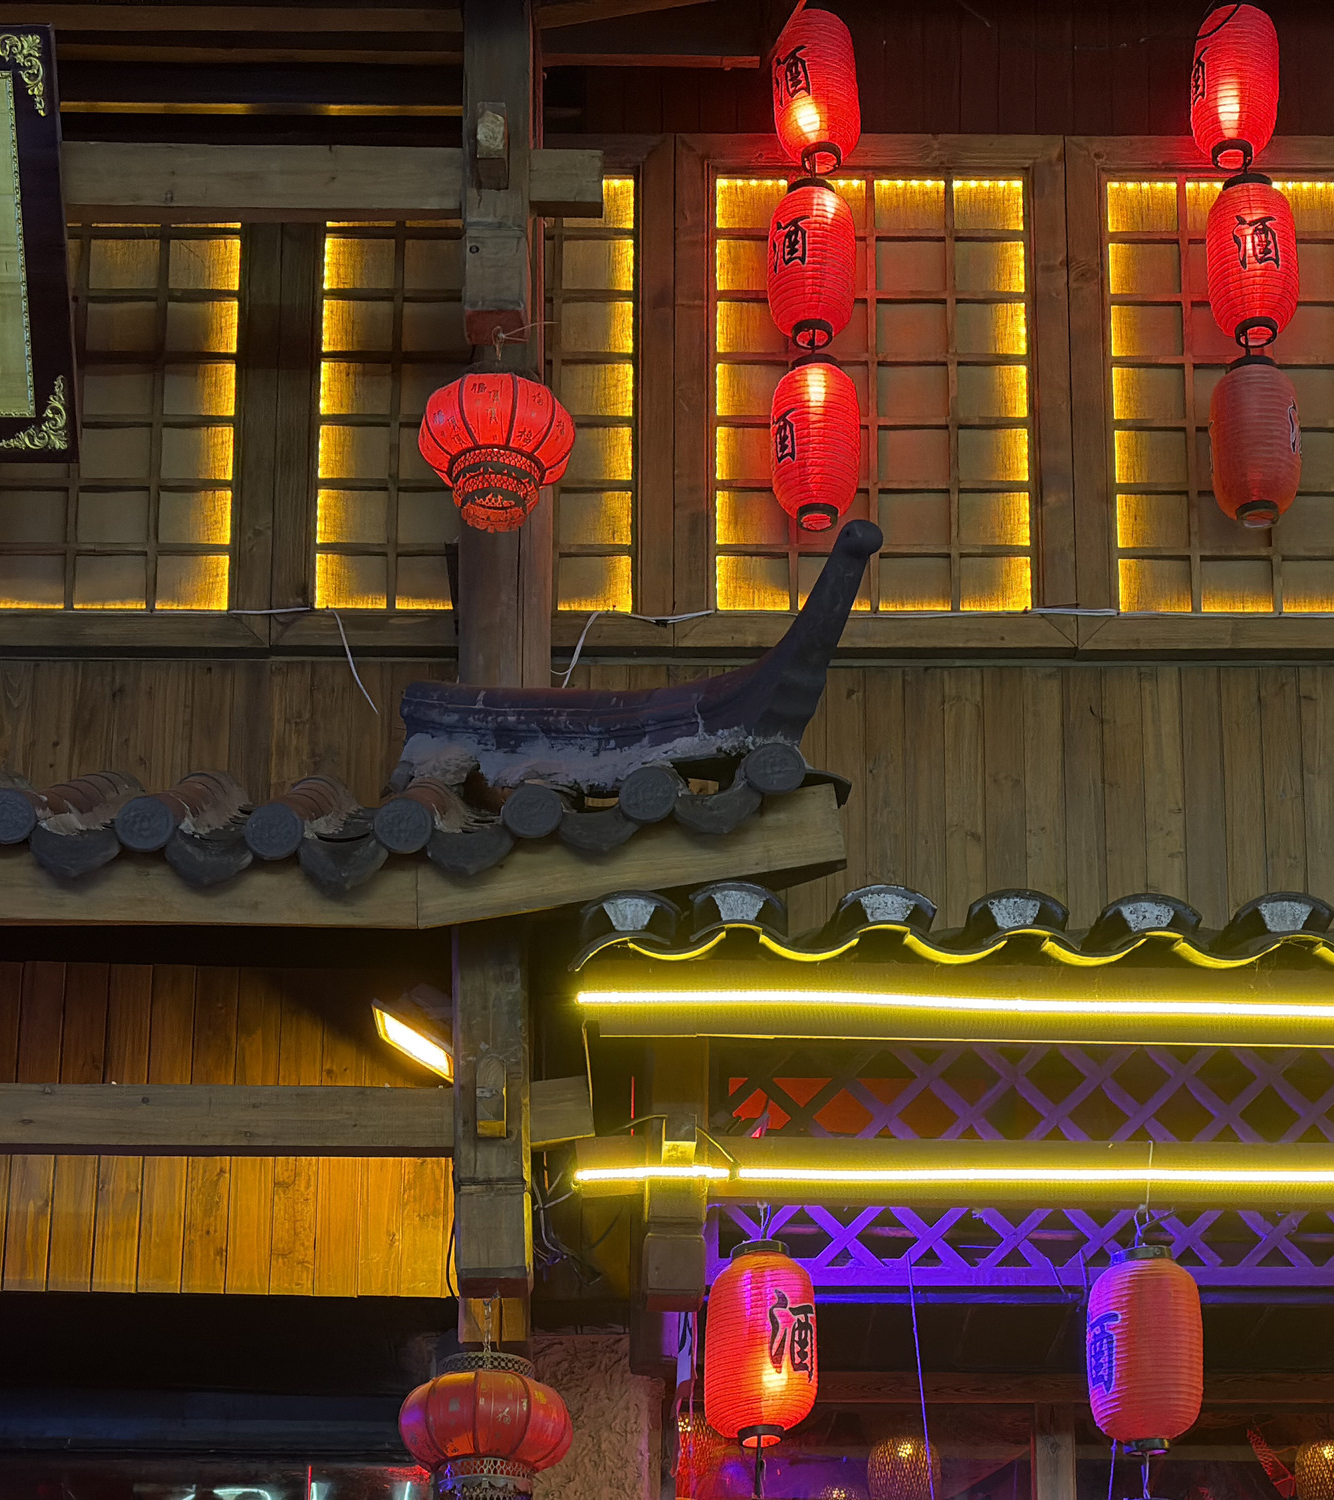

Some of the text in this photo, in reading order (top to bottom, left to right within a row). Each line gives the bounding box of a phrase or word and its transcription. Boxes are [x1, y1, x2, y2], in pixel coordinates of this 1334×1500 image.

[775, 45, 811, 107] 酒
[774, 216, 808, 273] 酒
[1233, 215, 1280, 270] 酒
[769, 1289, 815, 1383] 酒
